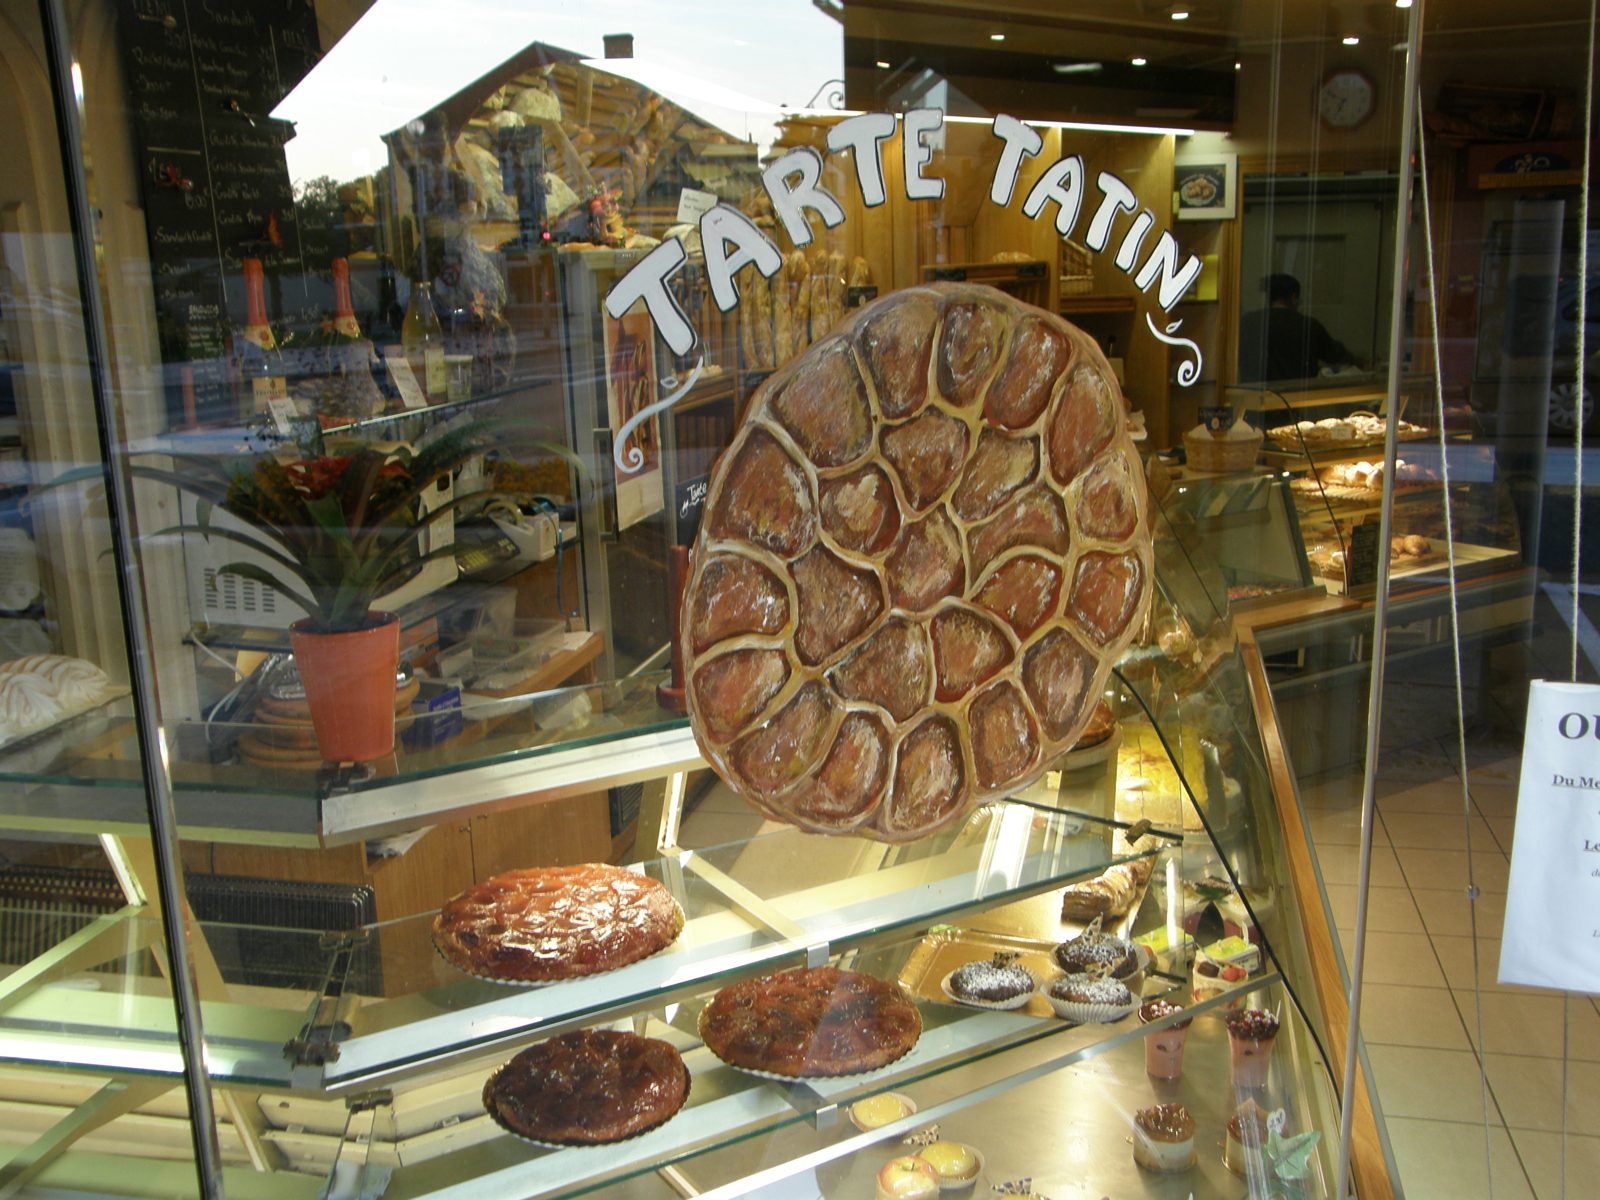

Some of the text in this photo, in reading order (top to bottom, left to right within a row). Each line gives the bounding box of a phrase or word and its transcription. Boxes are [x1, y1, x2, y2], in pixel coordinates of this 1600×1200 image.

[606, 107, 1203, 357] TARTE TATIN
[1552, 774, 1574, 787] Du
